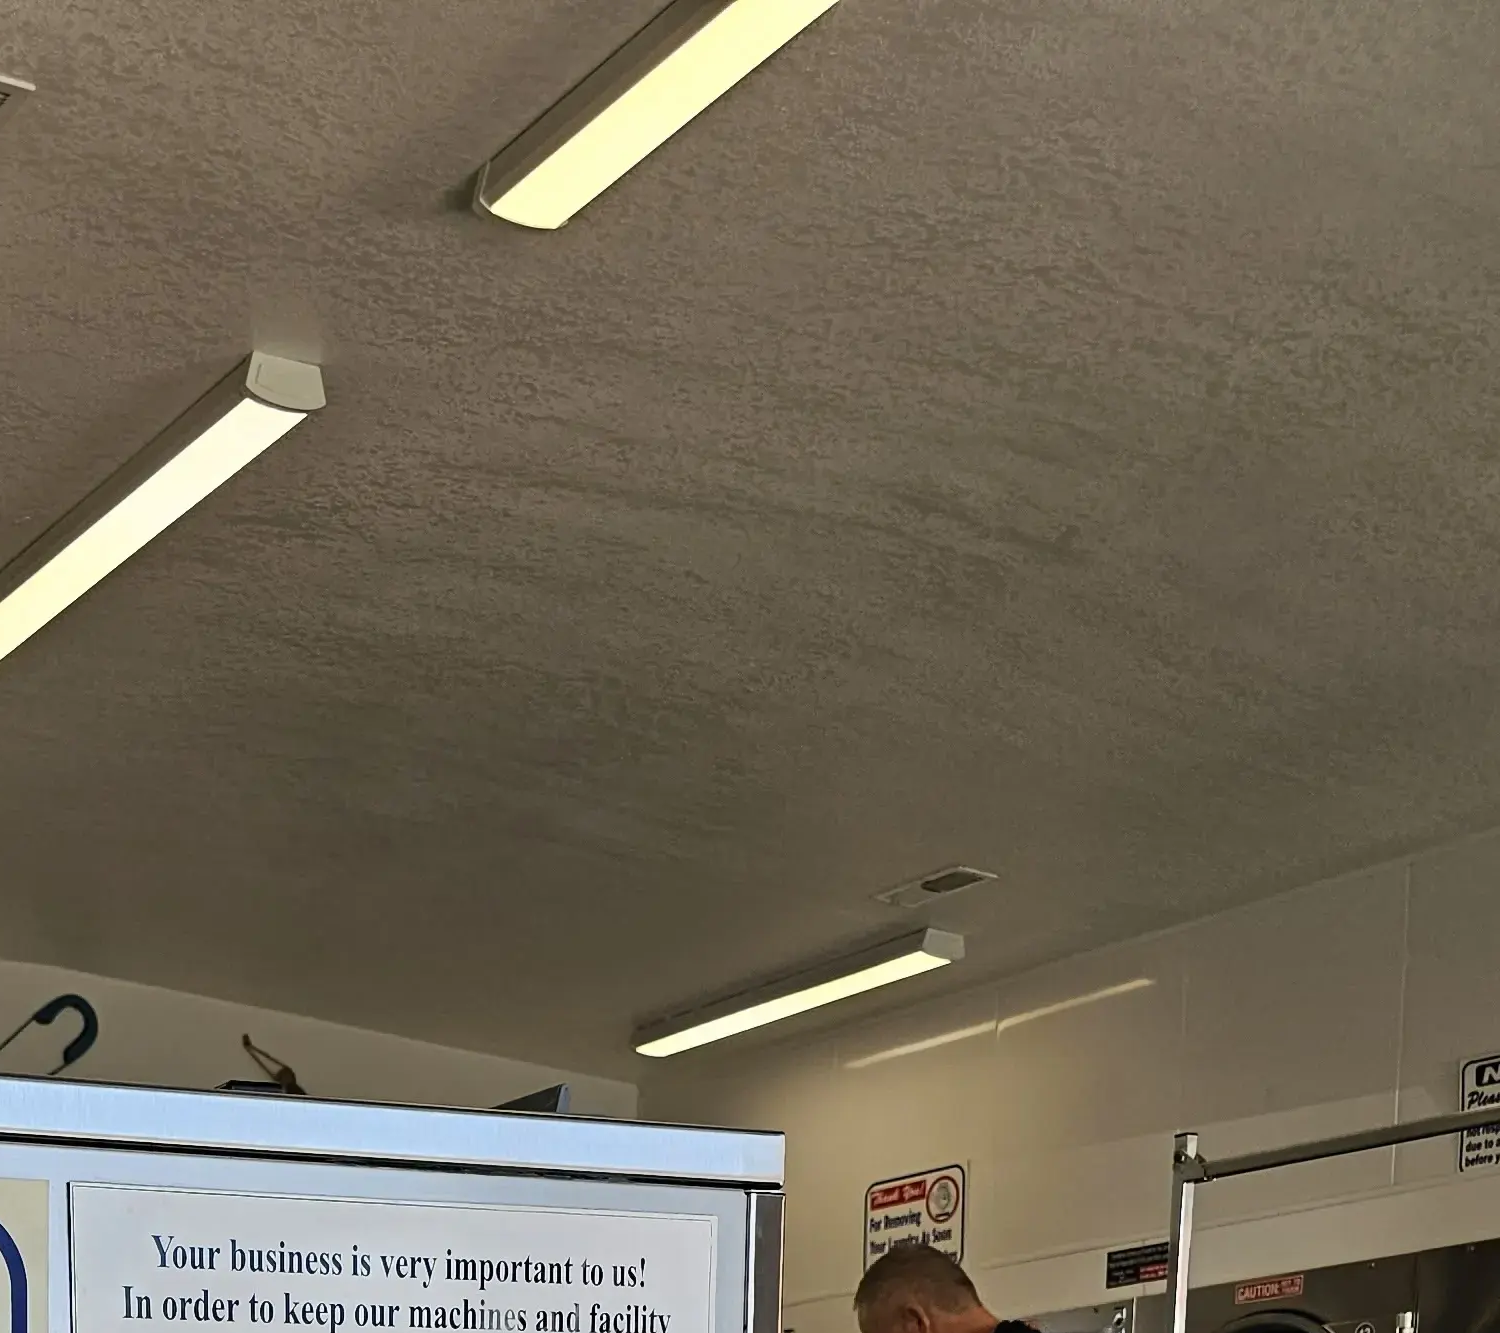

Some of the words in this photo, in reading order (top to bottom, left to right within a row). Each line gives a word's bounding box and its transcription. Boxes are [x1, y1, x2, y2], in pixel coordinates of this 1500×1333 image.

[151, 1235, 220, 1270] Your
[230, 1239, 342, 1275] business
[352, 1245, 370, 1276] is
[380, 1256, 437, 1288] very
[445, 1249, 573, 1290] important
[581, 1259, 603, 1286] to
[612, 1258, 645, 1287] us!
[122, 1286, 152, 1319] In
[163, 1289, 239, 1322] order
[249, 1293, 273, 1323] to
[355, 1304, 400, 1327] our
[409, 1299, 526, 1331] machines
[536, 1303, 580, 1333] and
